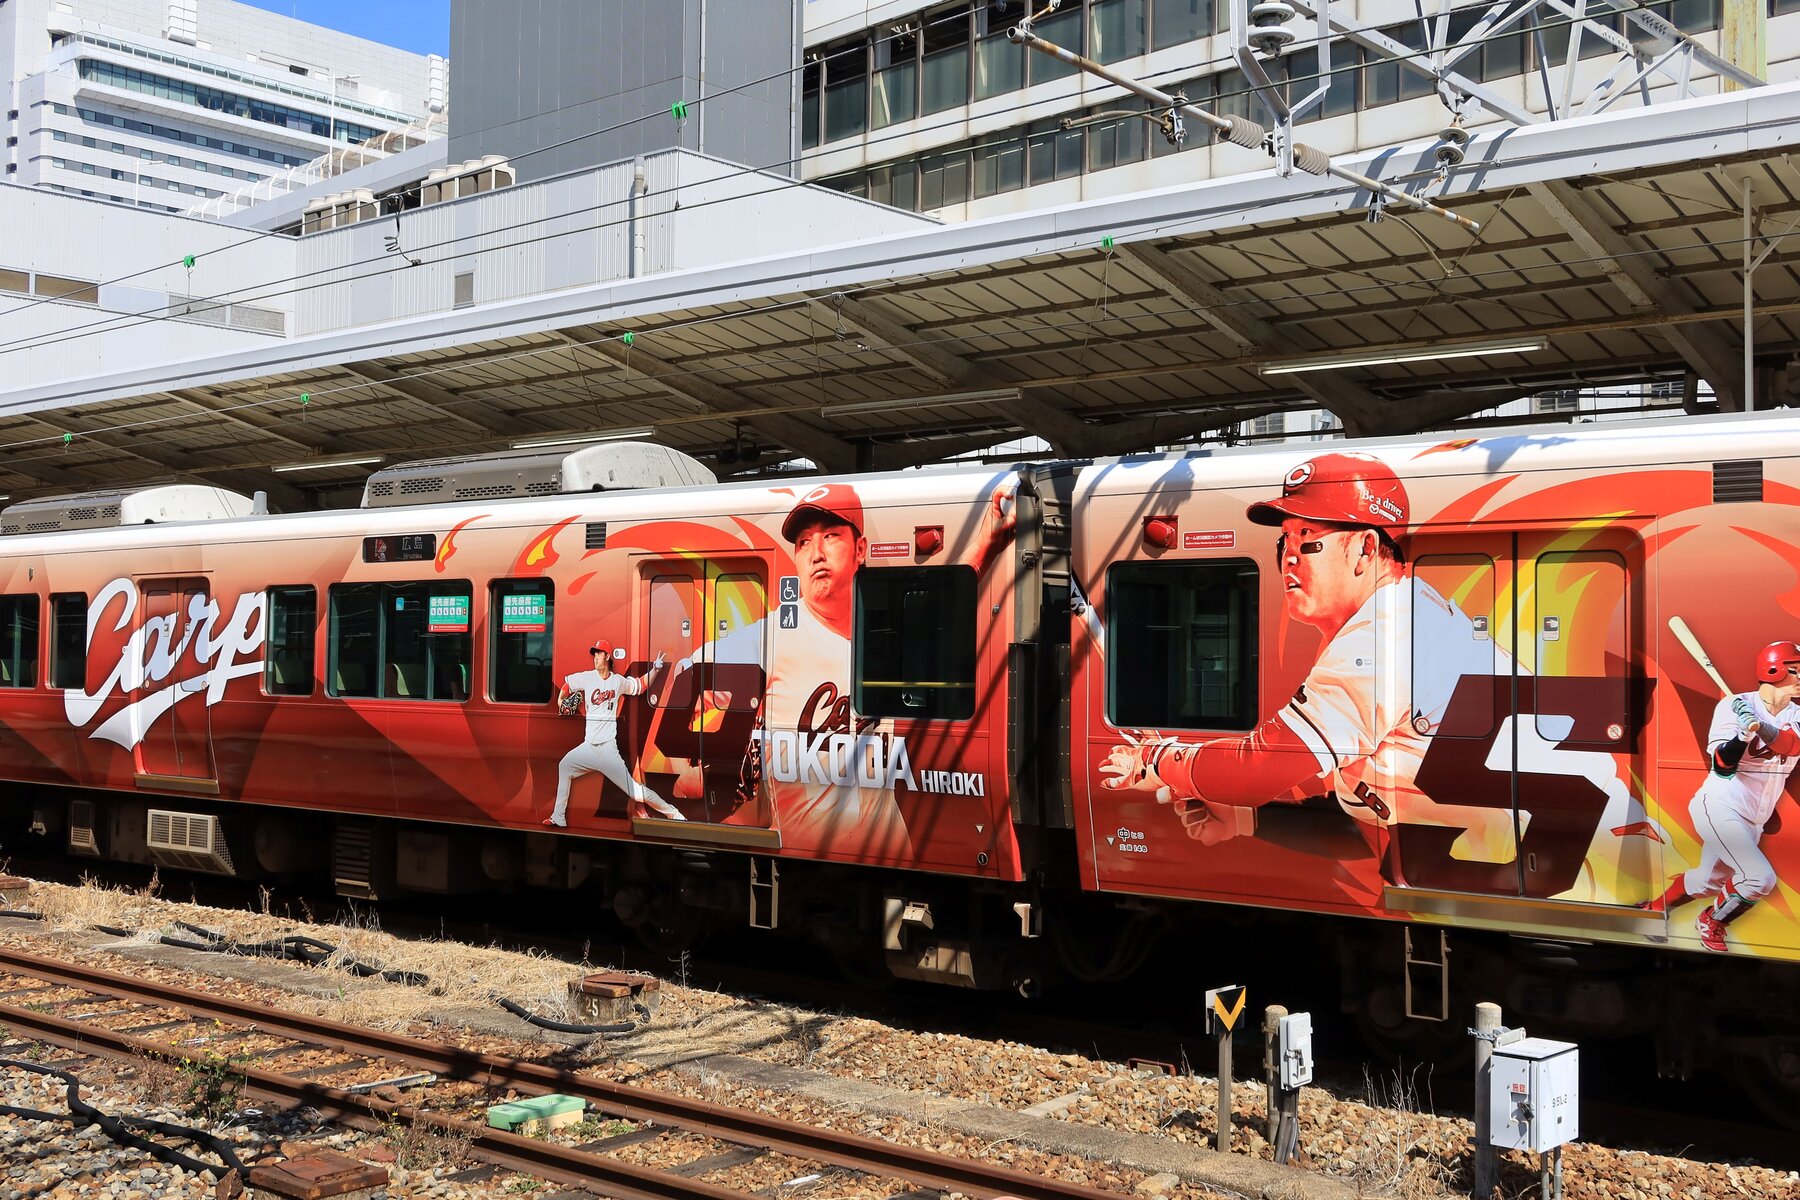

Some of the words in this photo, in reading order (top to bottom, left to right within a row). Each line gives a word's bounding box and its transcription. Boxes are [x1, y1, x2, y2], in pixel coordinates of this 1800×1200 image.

[1363, 489, 1375, 502] Be
[402, 536, 424, 550] 広島
[64, 577, 267, 752] Carp
[752, 729, 919, 791] TOKODA
[920, 769, 985, 797] HIROKI
